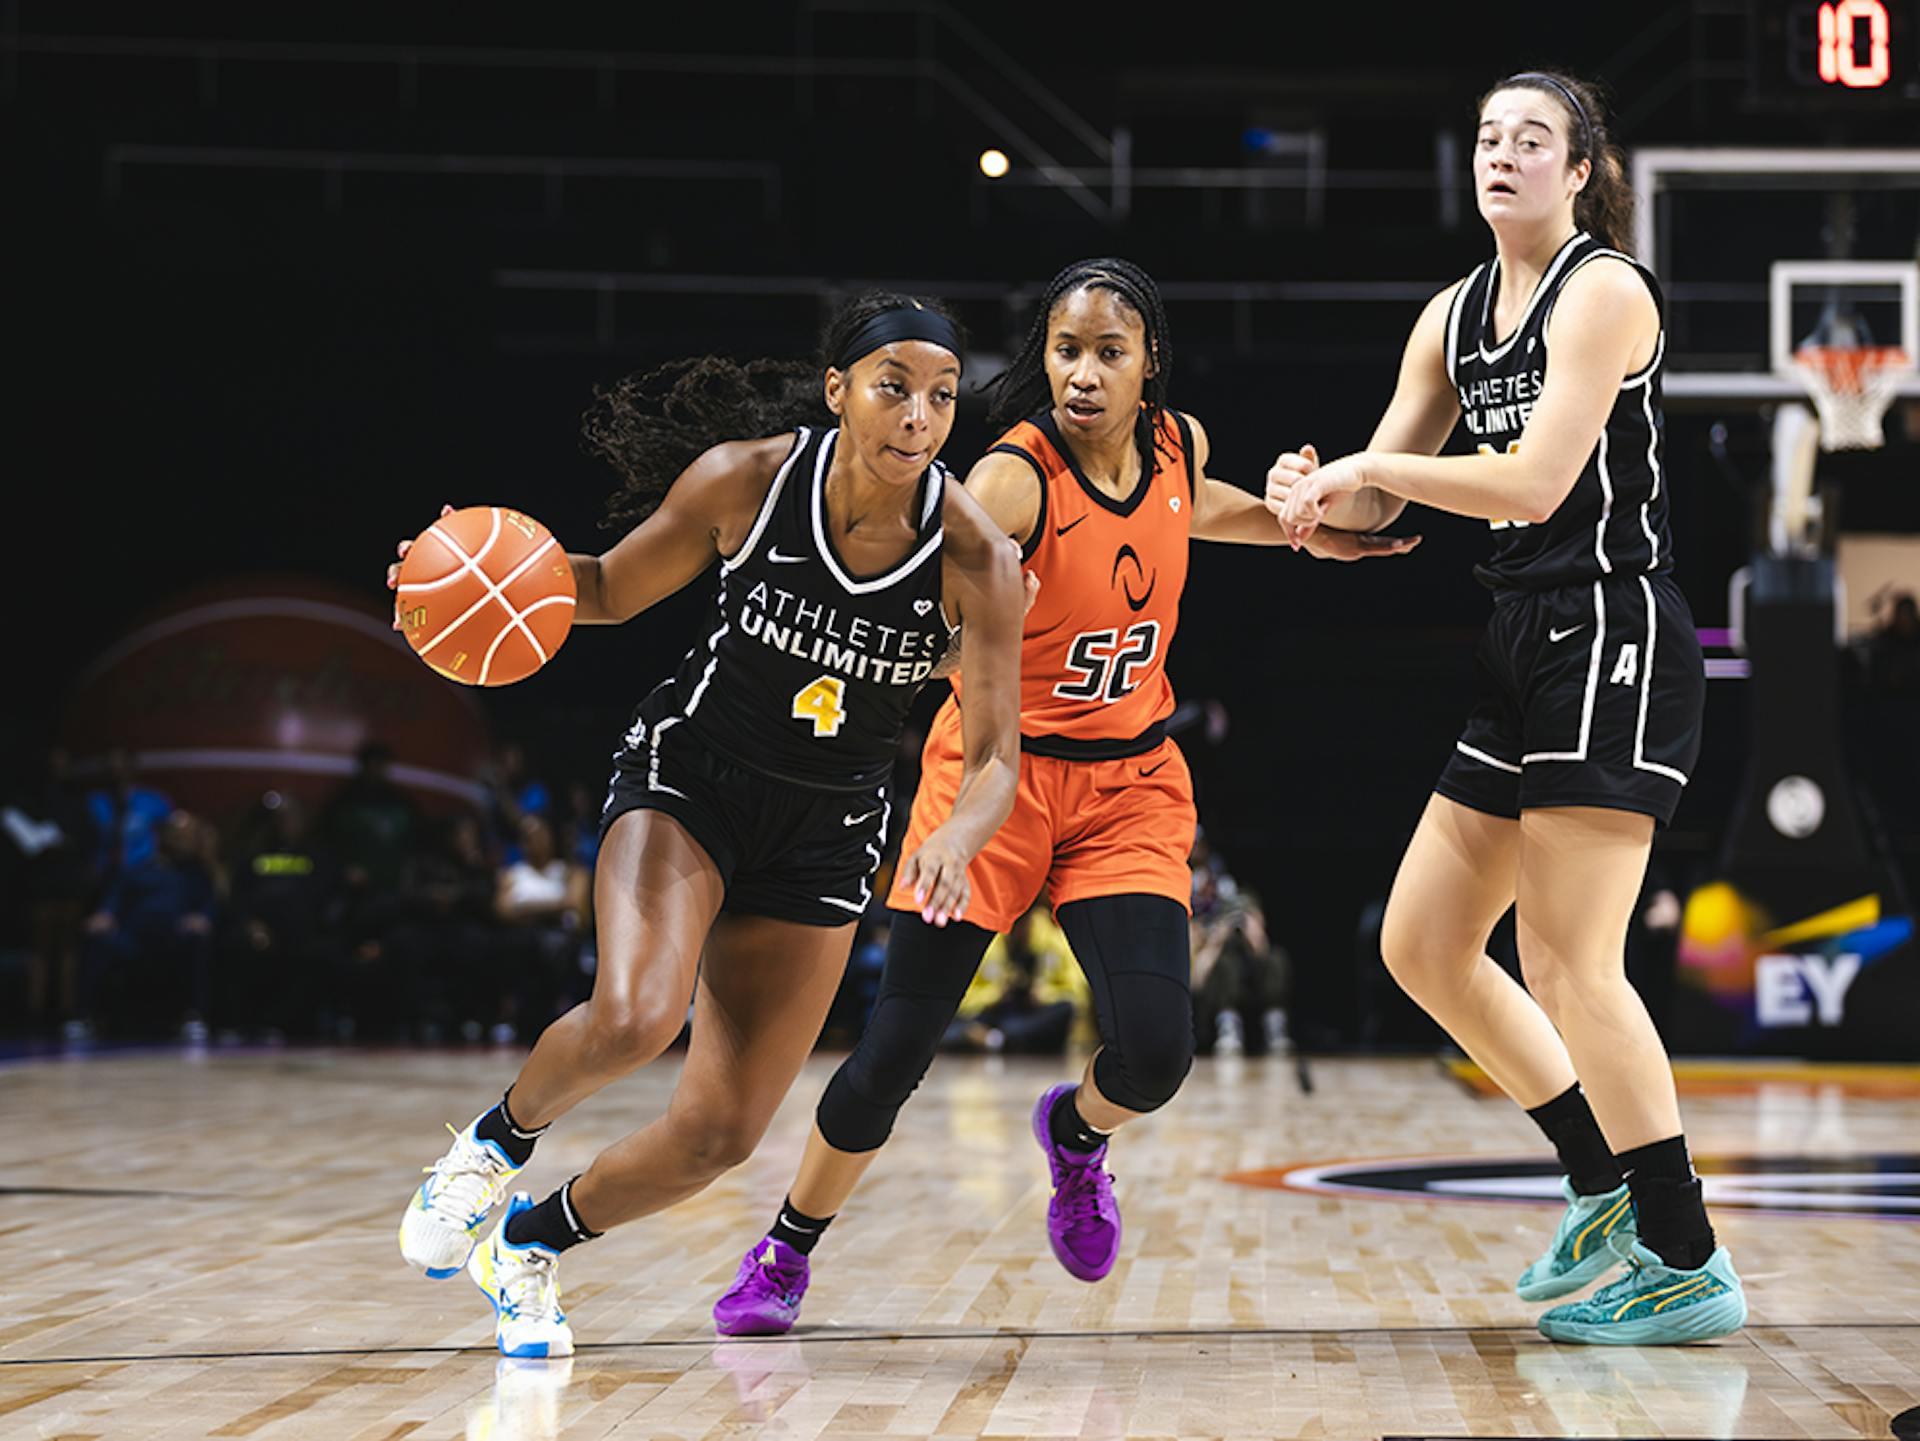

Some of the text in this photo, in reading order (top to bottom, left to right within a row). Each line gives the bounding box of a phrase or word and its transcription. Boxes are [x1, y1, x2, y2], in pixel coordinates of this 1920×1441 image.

[1817, 0, 1891, 88] 10
[739, 605, 933, 686] UNLIMITED
[747, 581, 937, 658] ATHLETES
[1052, 619, 1160, 703] 52
[791, 674, 847, 738] 4
[1754, 952, 1862, 1028] EY
